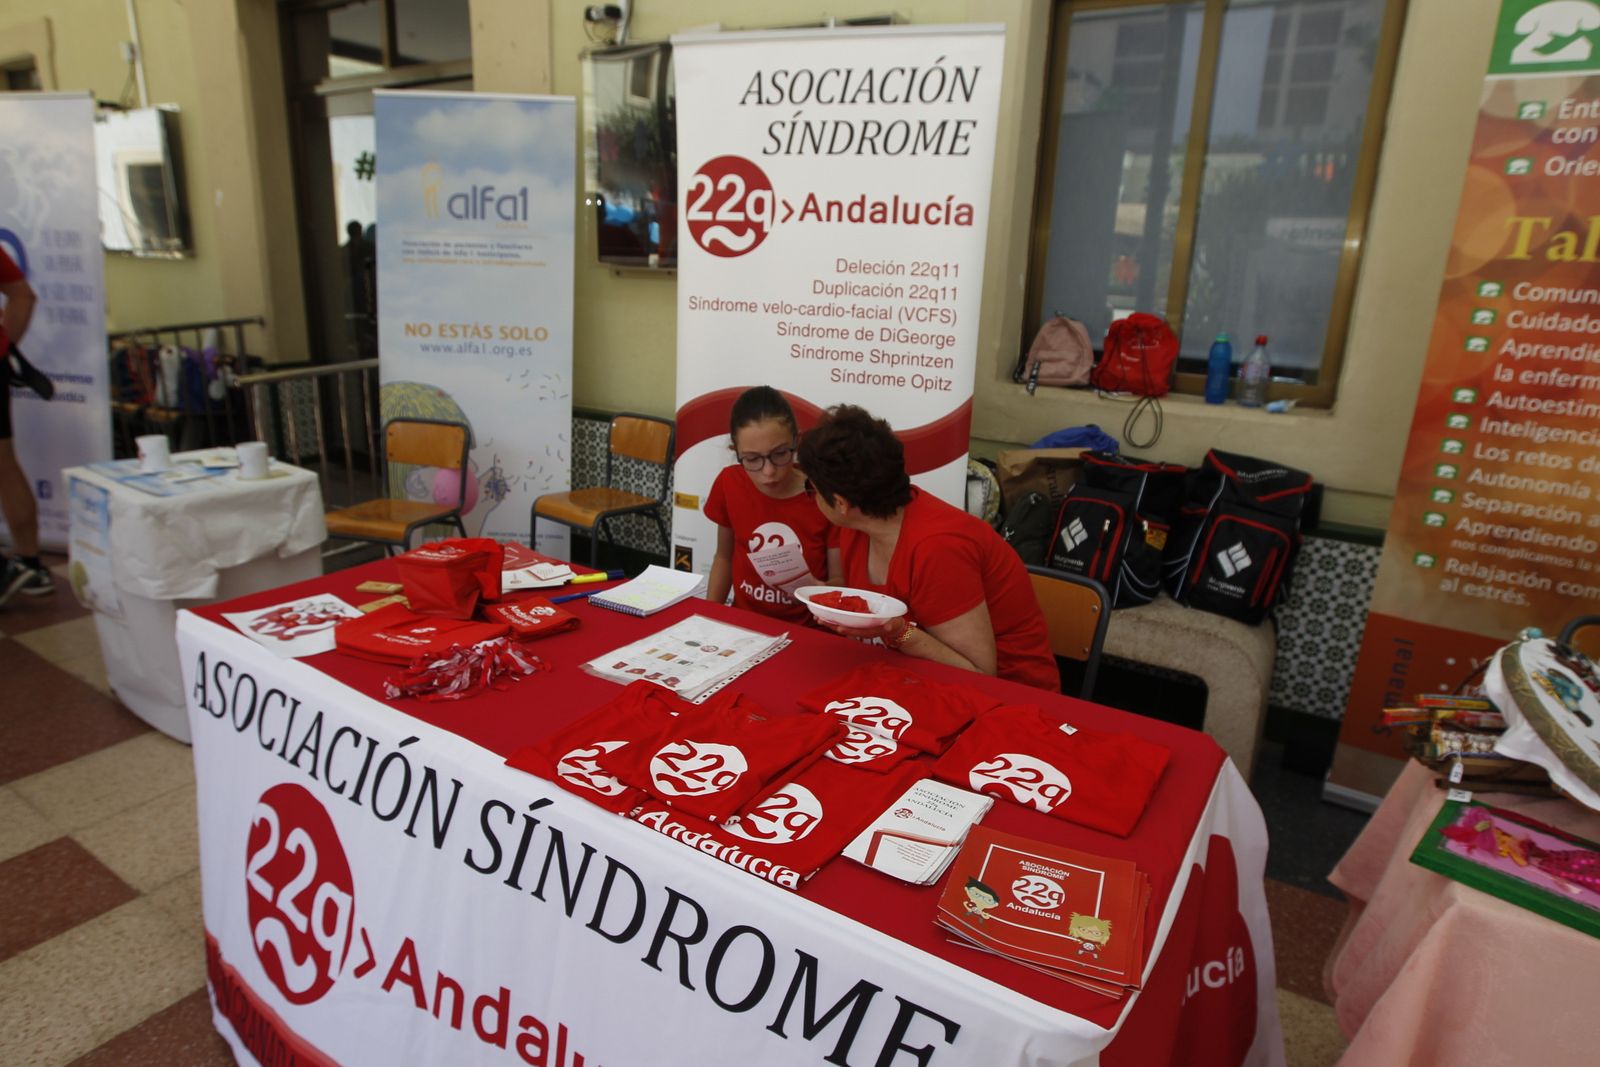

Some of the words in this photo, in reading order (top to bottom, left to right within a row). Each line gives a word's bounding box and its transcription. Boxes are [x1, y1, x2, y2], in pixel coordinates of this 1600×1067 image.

[739, 56, 981, 105] ASOCIACIÓN
[763, 110, 978, 156] SÍNDROME
[1551, 126, 1598, 144] con
[1544, 155, 1600, 176] Orie
[687, 173, 774, 233] 22q
[799, 192, 974, 226] Andalucía
[835, 258, 905, 276] Deleción
[910, 261, 960, 280] 22q11
[812, 279, 904, 299] Duplicación
[908, 283, 959, 303] 22q11
[1513, 282, 1600, 304] Comun
[688, 296, 759, 312] Síndrome
[762, 301, 893, 321] velo-cardio-facial
[898, 306, 958, 327] (VCFS)
[404, 322, 433, 337] NO
[438, 323, 493, 339] ESTÁS
[499, 326, 549, 341] SOLO
[776, 321, 850, 340] Síndrome
[854, 326, 875, 341] de
[879, 327, 956, 350] DiGeorge
[419, 342, 533, 357] www.alfa1.org.es
[790, 344, 864, 363] Síndrome
[869, 348, 954, 369] Shprintzen
[830, 368, 906, 388] Síndrome
[910, 374, 953, 393] Opitz
[1493, 363, 1514, 382] la
[1473, 442, 1511, 462] Los
[1514, 450, 1574, 470] retos
[1466, 467, 1592, 499] Autonomía
[1461, 491, 1582, 525] Separación
[1454, 516, 1598, 552] Aprendiendo
[1450, 538, 1477, 551] nos
[1478, 542, 1575, 568] complicamos
[1443, 557, 1553, 591] Relajación
[1439, 578, 1460, 593] al
[1462, 583, 1531, 607] estrés.
[193, 651, 463, 850] ASOCIACIÓN
[972, 756, 1069, 809] 22q
[1019, 860, 1070, 877] ASOCIACIÓN
[1013, 878, 1064, 905] 22q
[246, 801, 353, 982] 22q
[381, 937, 602, 1067] Andal
